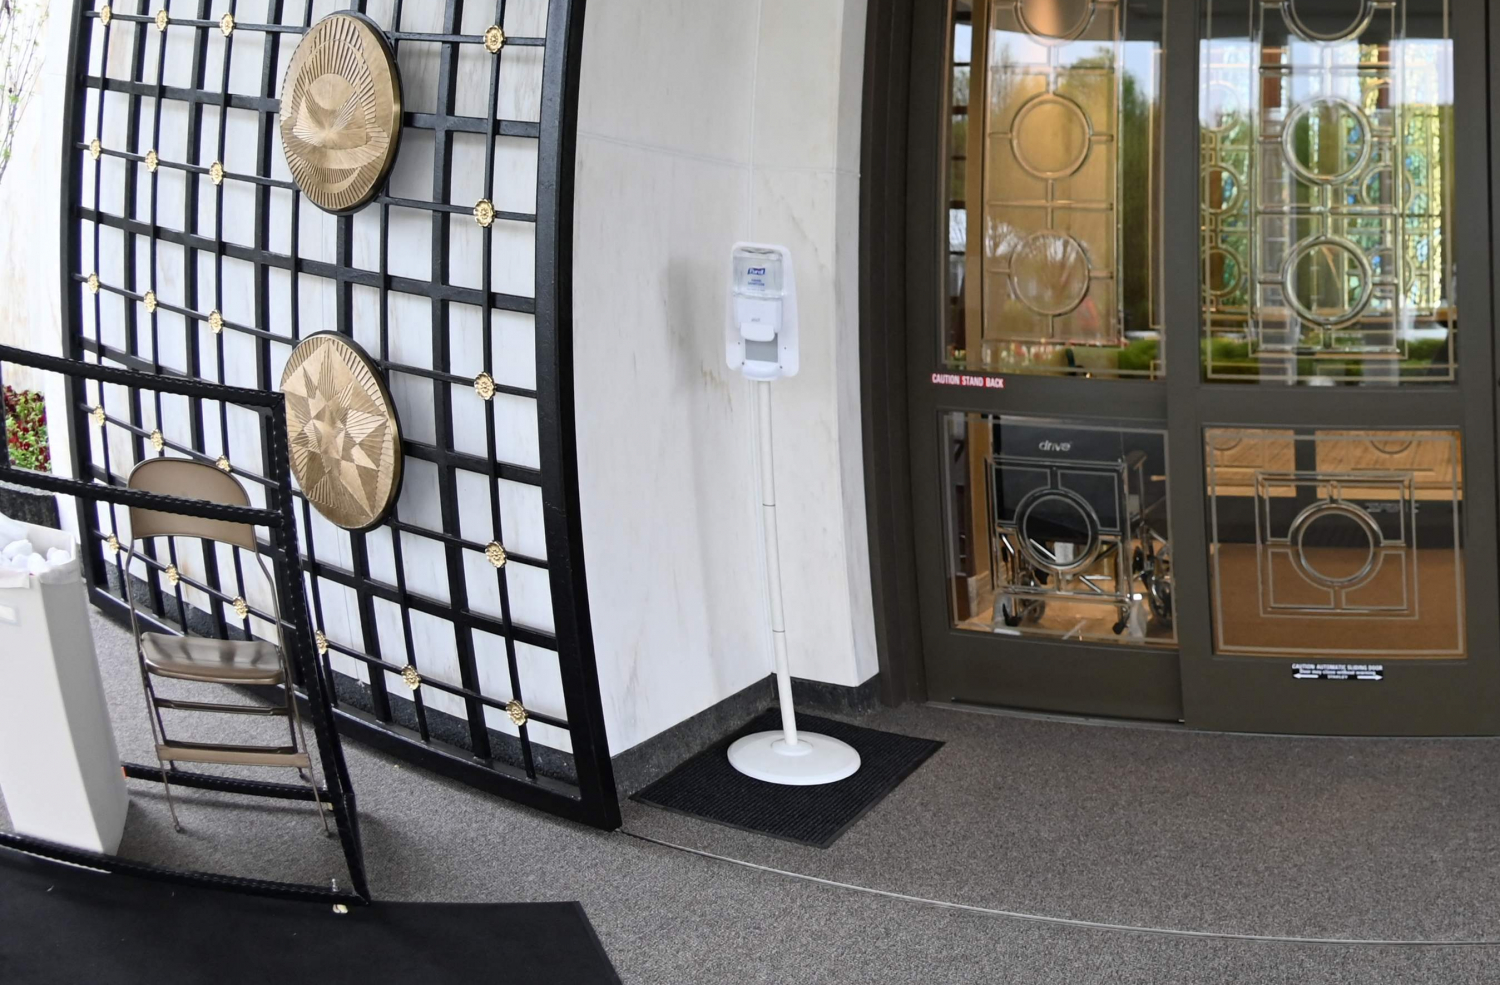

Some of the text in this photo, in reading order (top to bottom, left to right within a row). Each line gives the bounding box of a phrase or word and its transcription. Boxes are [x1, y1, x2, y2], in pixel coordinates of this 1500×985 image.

[932, 373, 1004, 388] CAUTION STAND BACK
[1039, 440, 1071, 451] drive
